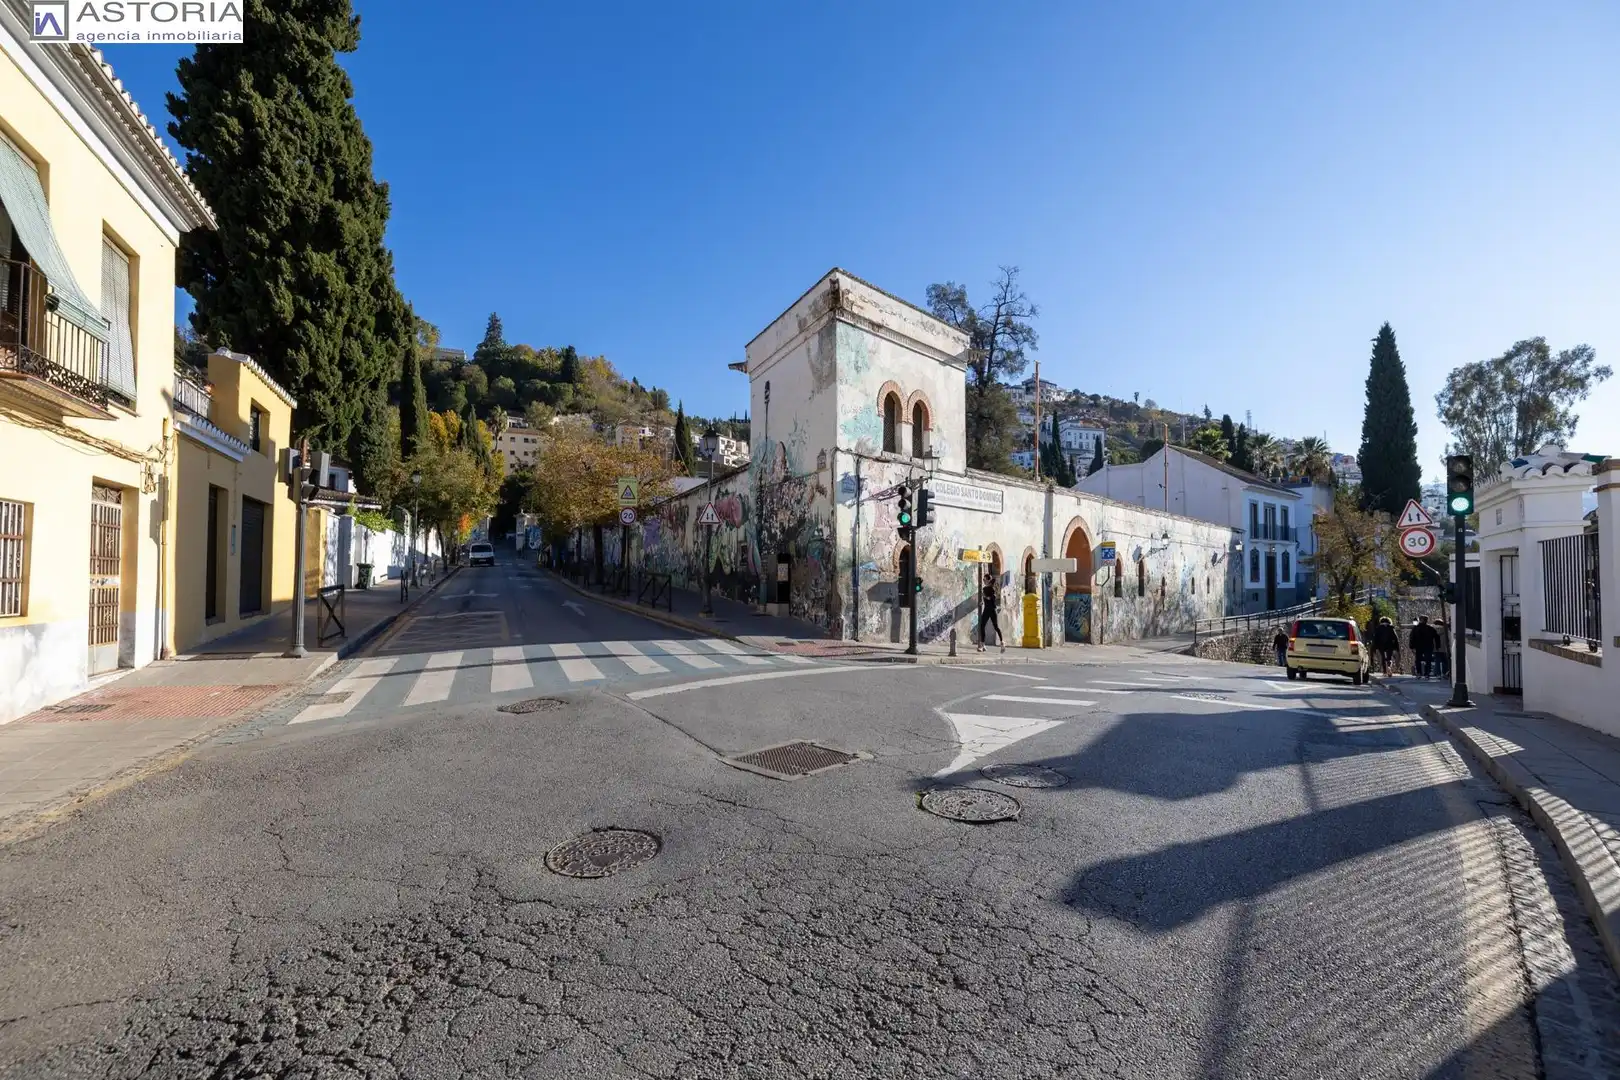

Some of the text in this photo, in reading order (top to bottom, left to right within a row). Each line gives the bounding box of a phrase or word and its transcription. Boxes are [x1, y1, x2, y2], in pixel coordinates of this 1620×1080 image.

[935, 482, 960, 496] COLEGIO
[961, 487, 978, 499] SANTO
[979, 489, 1002, 503] DOMINGO
[1408, 536, 1427, 547] 30
